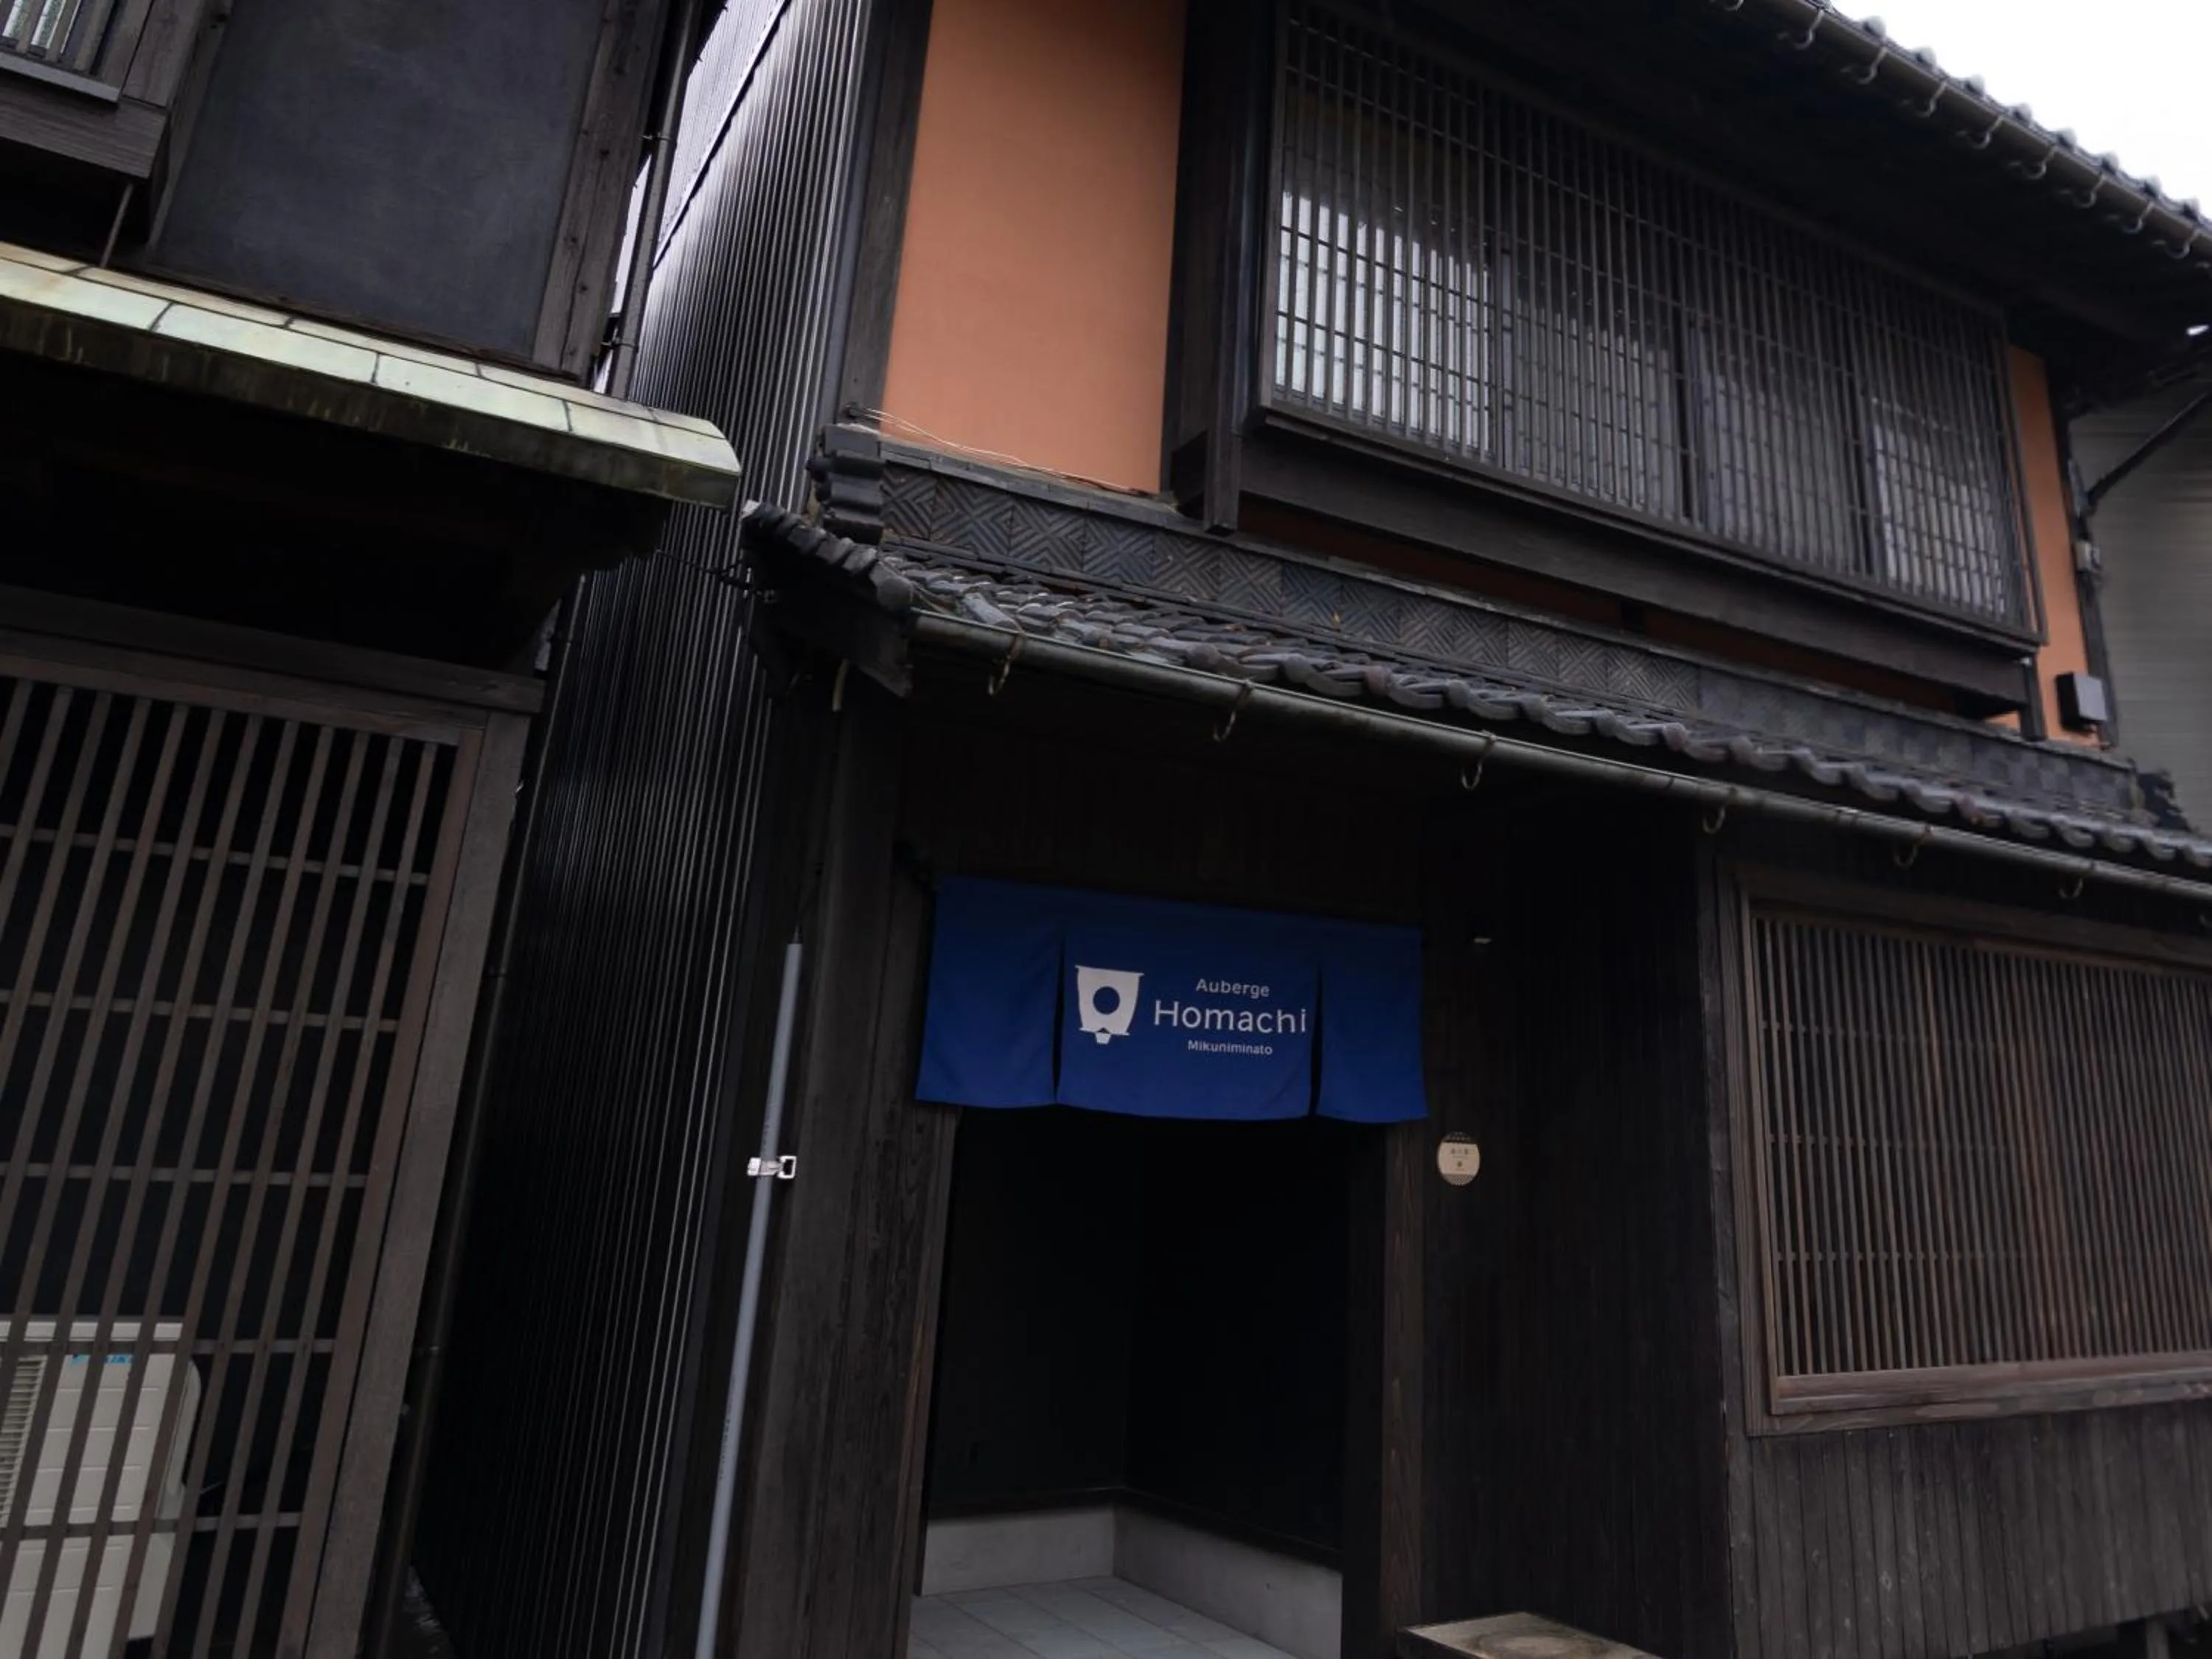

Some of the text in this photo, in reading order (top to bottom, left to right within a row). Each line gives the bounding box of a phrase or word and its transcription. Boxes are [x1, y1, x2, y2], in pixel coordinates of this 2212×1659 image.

[1195, 978, 1270, 998] Auberge
[1153, 1000, 1307, 1033] Homachi
[1188, 1040, 1273, 1055] Mikuniminato
